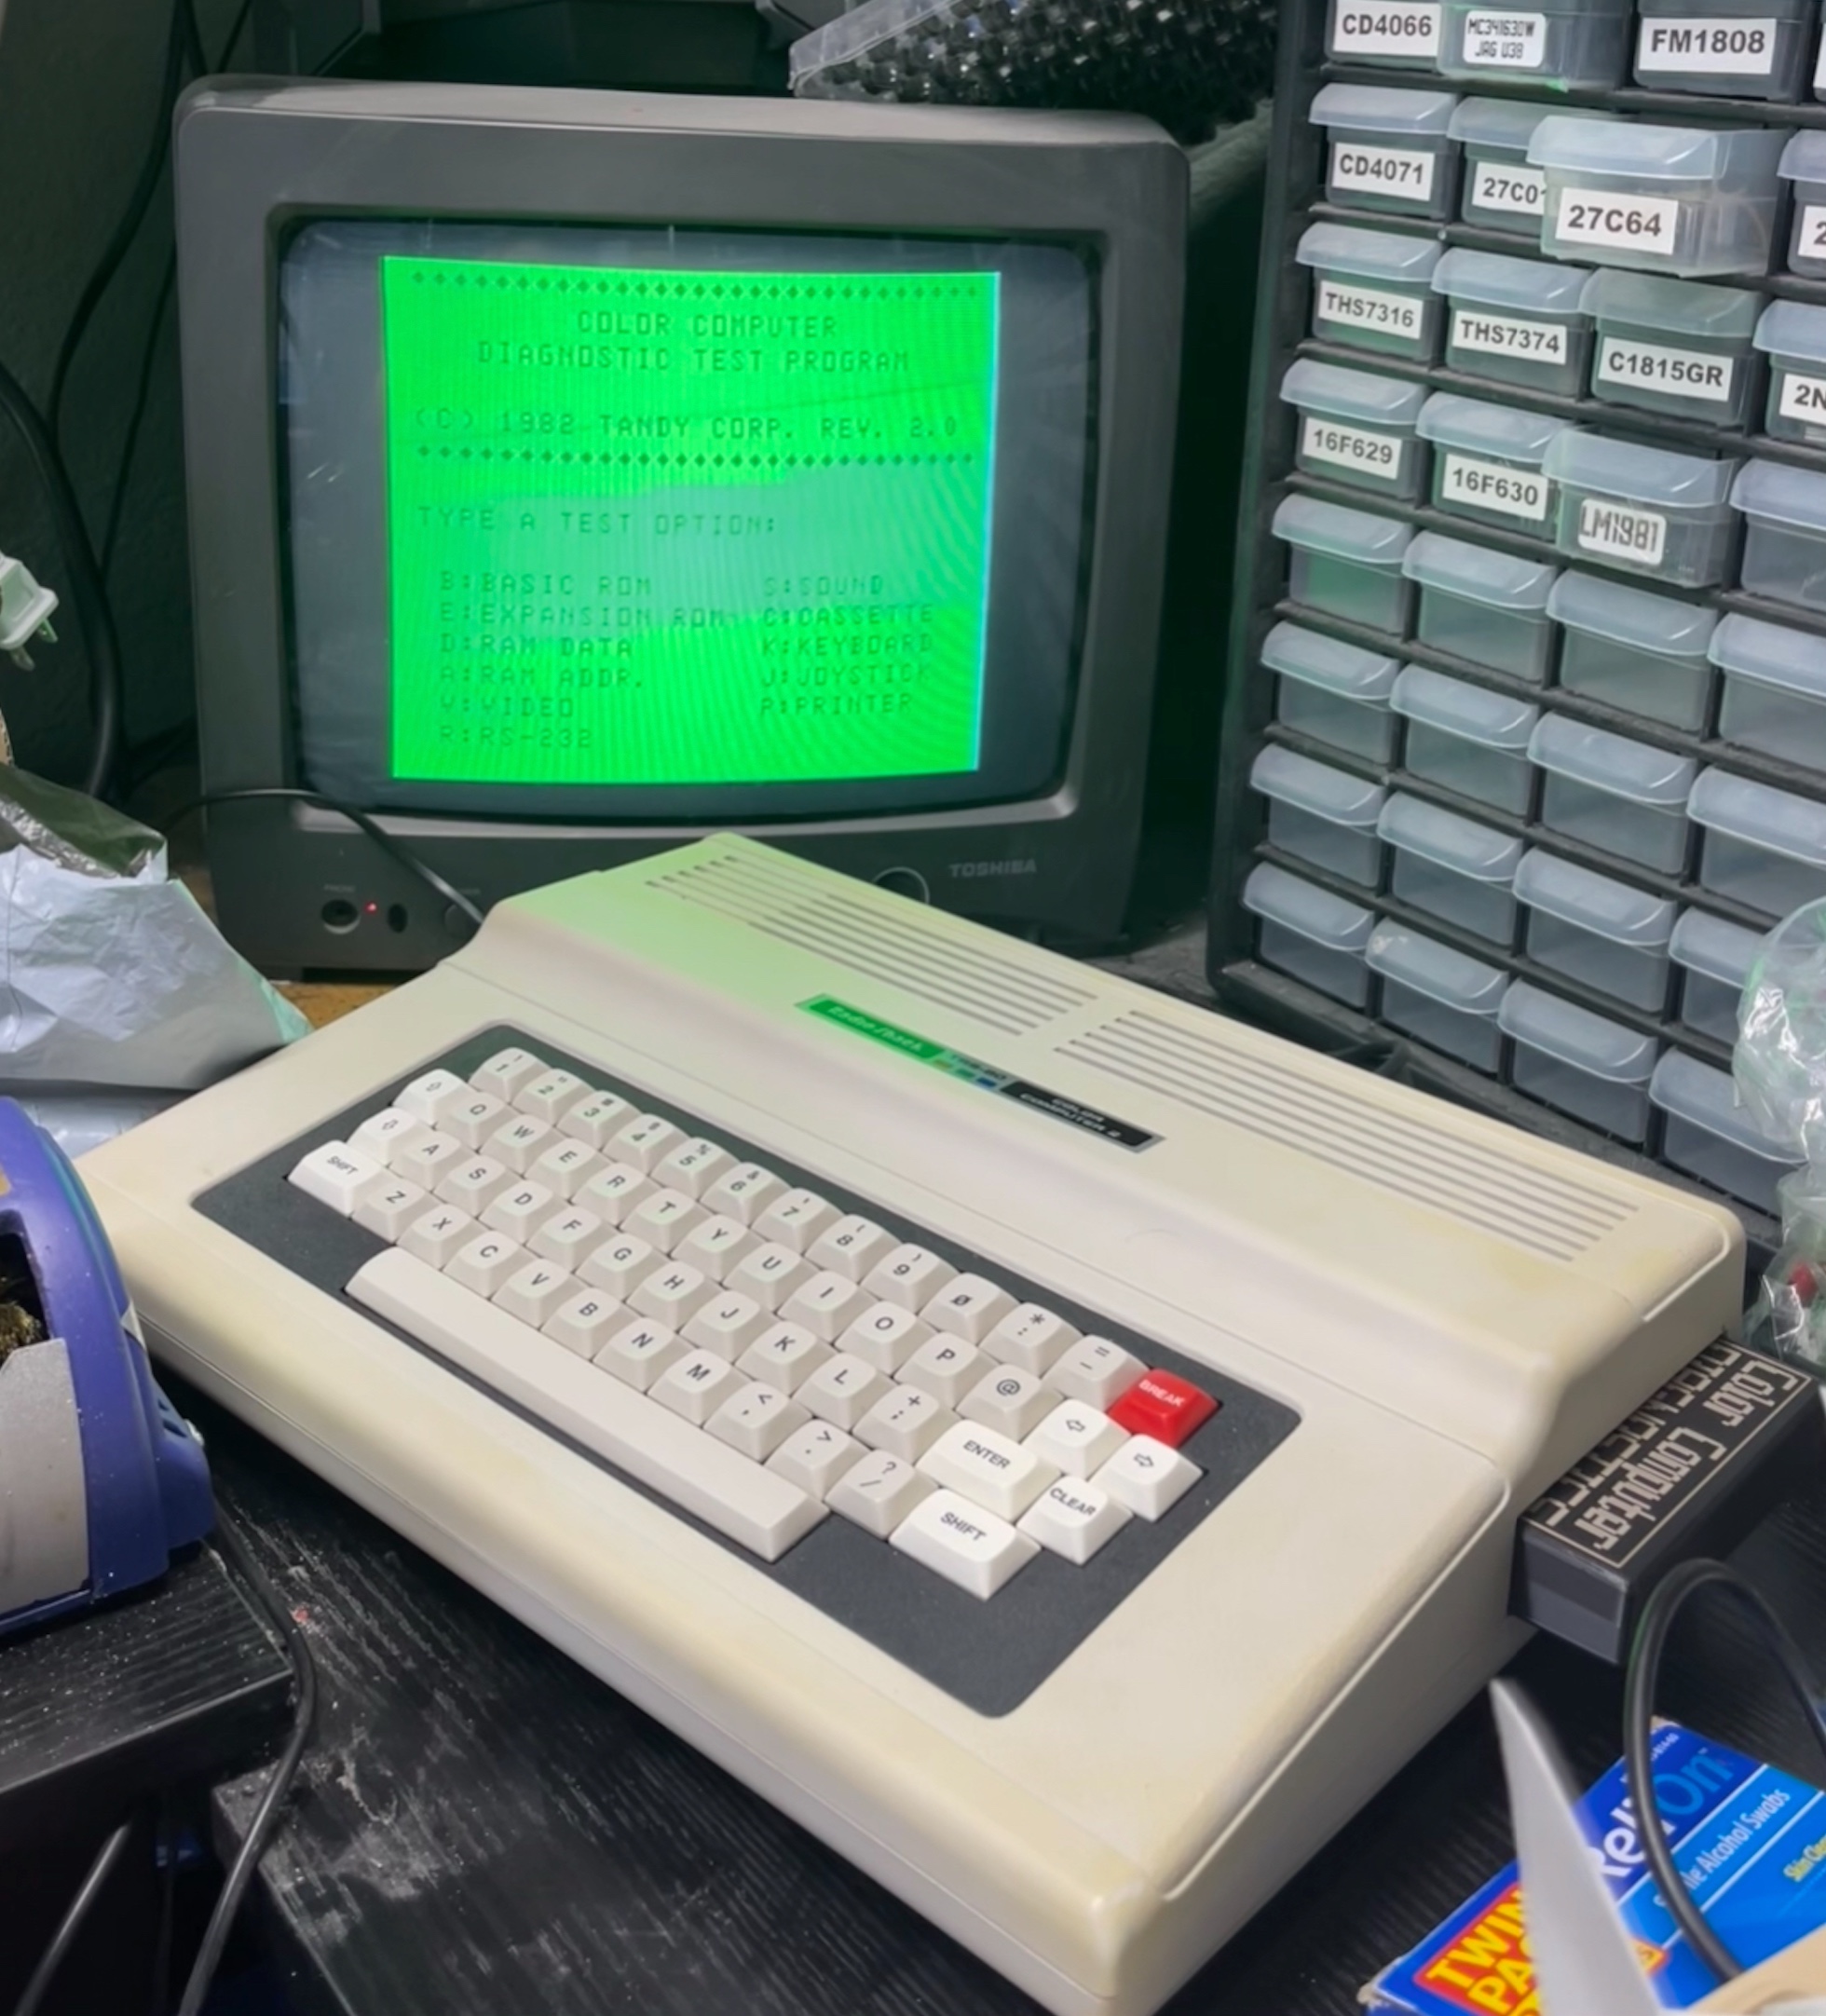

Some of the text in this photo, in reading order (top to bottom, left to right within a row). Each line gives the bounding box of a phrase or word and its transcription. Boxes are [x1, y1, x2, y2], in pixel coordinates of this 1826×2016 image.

[1342, 13, 1432, 37] CD4066
[1650, 29, 1765, 54] FM1808
[1475, 41, 1524, 60] JAG U38
[1340, 154, 1424, 184] CD4071
[1568, 204, 1662, 238] 27C64
[1325, 292, 1414, 328] THS7316
[578, 309, 837, 339] COLOR COMPUTER
[1460, 320, 1560, 354] THS7374
[477, 341, 910, 373] DIAGNOSTIC TEST PROGRAM
[1609, 350, 1724, 388] C1815GR
[501, 411, 575, 436] 1982
[599, 415, 691, 439] TANDY
[712, 415, 794, 440] CORP.
[821, 416, 883, 440] REV.
[909, 415, 958, 438] 2.0
[1313, 428, 1394, 465] 16F629
[1452, 467, 1539, 507] 16F630
[417, 506, 496, 530] TYPE
[520, 512, 537, 532] A
[561, 512, 632, 534] TEST
[1581, 503, 1658, 553] LM1981
[597, 576, 651, 597] ROM
[561, 636, 634, 659] DATA
[560, 665, 645, 688] ADDR.
[949, 859, 1037, 878] TOSHIBA
[538, 1084, 554, 1096] 2
[583, 1107, 601, 1118] 3
[513, 1124, 535, 1138] W
[631, 1132, 647, 1142] 4
[422, 1144, 440, 1156] A
[558, 1150, 578, 1164] E
[326, 1155, 359, 1175] SHIFT
[678, 1154, 697, 1166] 5
[468, 1167, 487, 1180] S
[606, 1175, 626, 1188] R
[729, 1180, 747, 1192] 6
[385, 1191, 406, 1204] Z
[513, 1192, 533, 1206] D
[660, 1201, 676, 1214] T
[782, 1206, 800, 1218] 7
[432, 1217, 452, 1231] X
[562, 1219, 582, 1231] F
[711, 1228, 729, 1241] Y
[836, 1234, 854, 1246] 8
[479, 1245, 499, 1259] C
[613, 1246, 633, 1261] G
[761, 1256, 783, 1271] U
[893, 1263, 911, 1276] 9
[531, 1273, 550, 1286] V
[663, 1274, 685, 1290] H
[579, 1301, 599, 1316] B
[720, 1308, 740, 1319] J
[874, 1316, 894, 1331] O
[631, 1332, 654, 1349] N
[774, 1335, 796, 1352] K
[935, 1348, 956, 1360] P
[687, 1363, 711, 1381] M
[833, 1369, 849, 1385] L
[996, 1379, 1021, 1396] @
[1138, 1379, 1186, 1408] BREAK
[963, 1439, 1012, 1469] ENTER
[1574, 1358, 1798, 1551] Color Computer
[1050, 1488, 1097, 1518] CLEAR
[940, 1511, 987, 1541] SHIFT
[1696, 1819, 1753, 1873] Alcohol
[1739, 1789, 1792, 1831] Swabs
